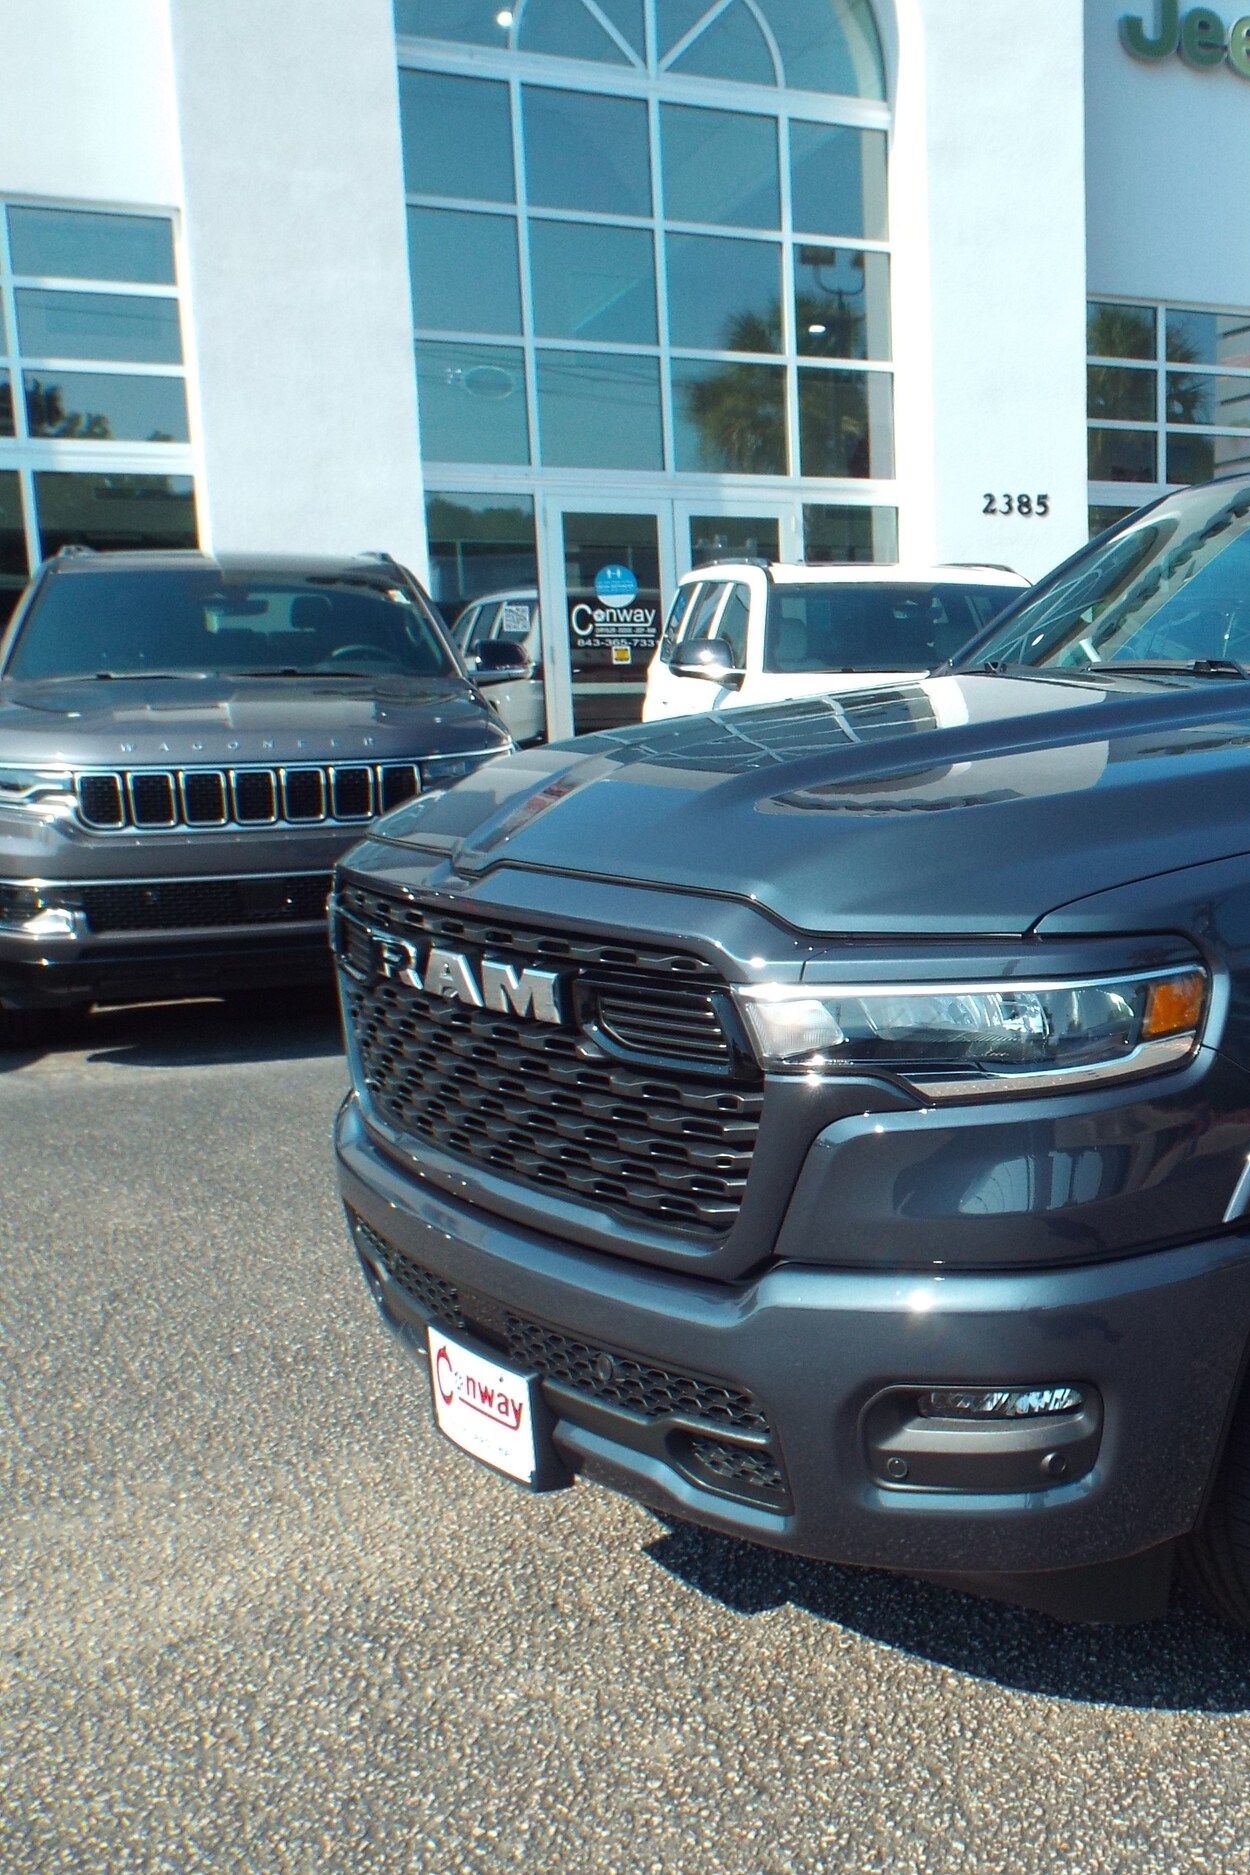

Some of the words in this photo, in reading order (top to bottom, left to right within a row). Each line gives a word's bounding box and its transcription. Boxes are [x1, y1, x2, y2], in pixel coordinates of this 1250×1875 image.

[982, 492, 1050, 517] 2385
[572, 604, 656, 636] Conway
[577, 638, 660, 648] 843-365-733
[120, 736, 375, 752] WAGONEER
[372, 927, 562, 1025] RAM
